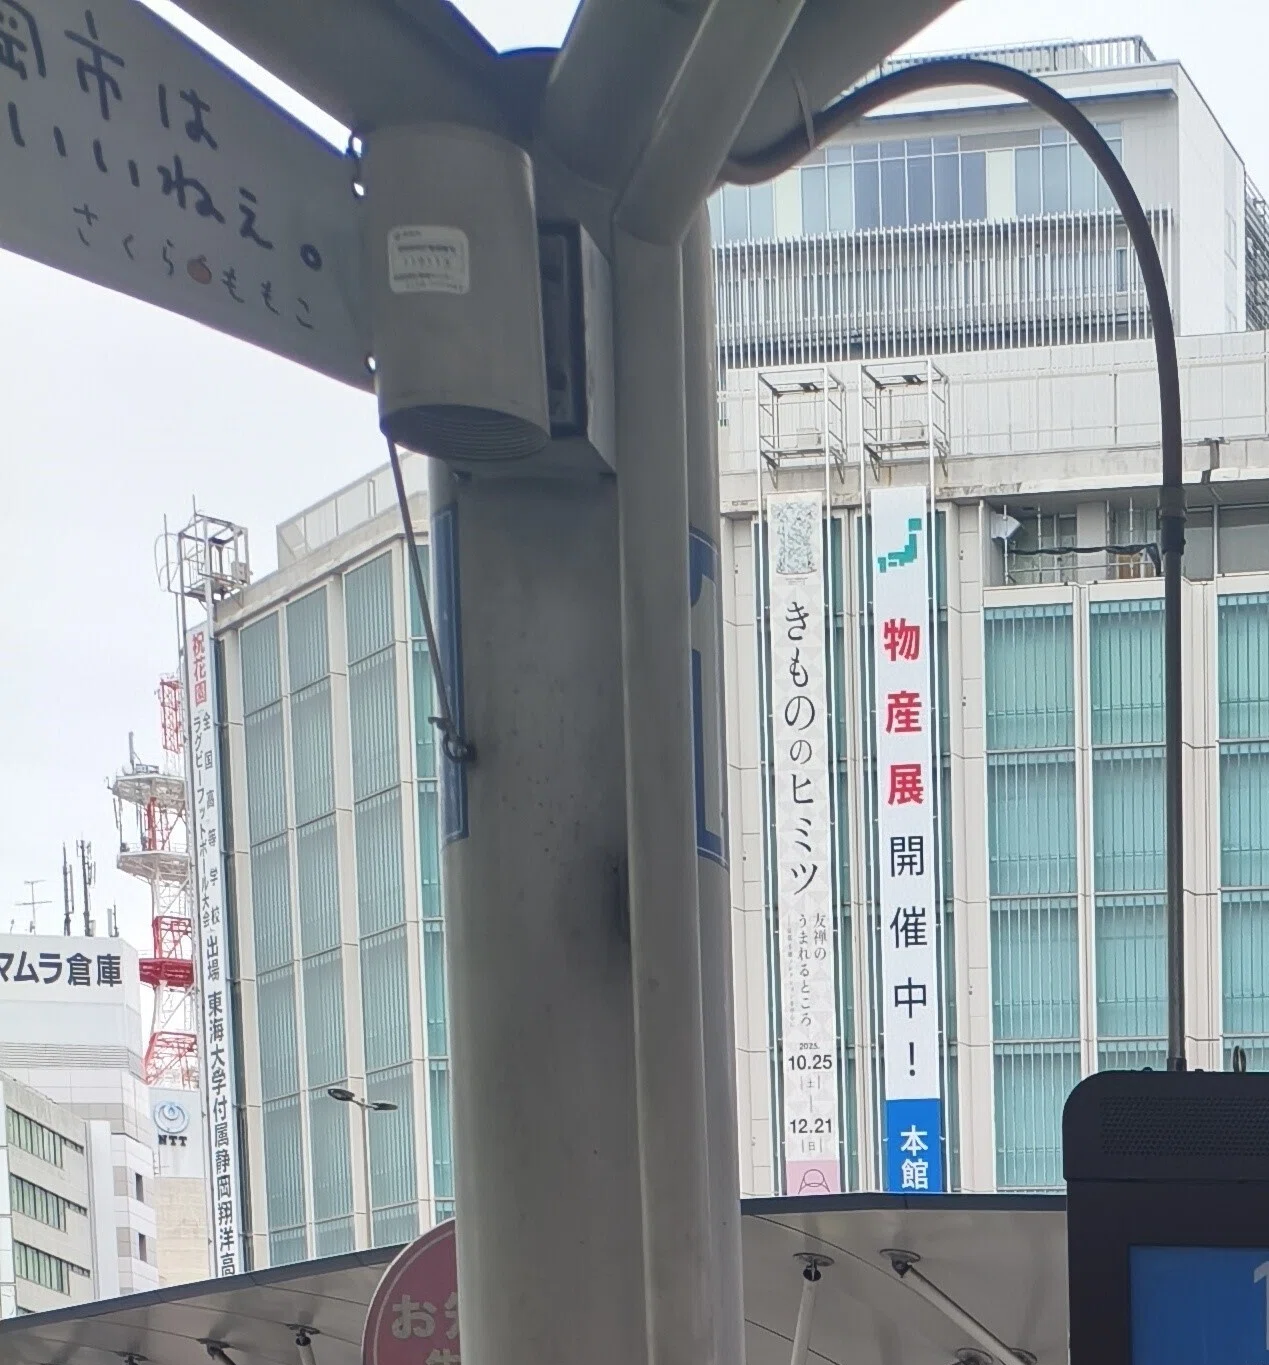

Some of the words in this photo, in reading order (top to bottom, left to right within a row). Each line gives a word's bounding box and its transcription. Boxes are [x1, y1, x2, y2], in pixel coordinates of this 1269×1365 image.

[784, 601, 819, 895] きもののヒミツ
[798, 914, 812, 1026] うまれるところ
[788, 1054, 832, 1071] 10.25
[158, 1134, 188, 1146] NTT
[789, 1119, 832, 1134] 12.21
[900, 1125, 929, 1191] 本館
